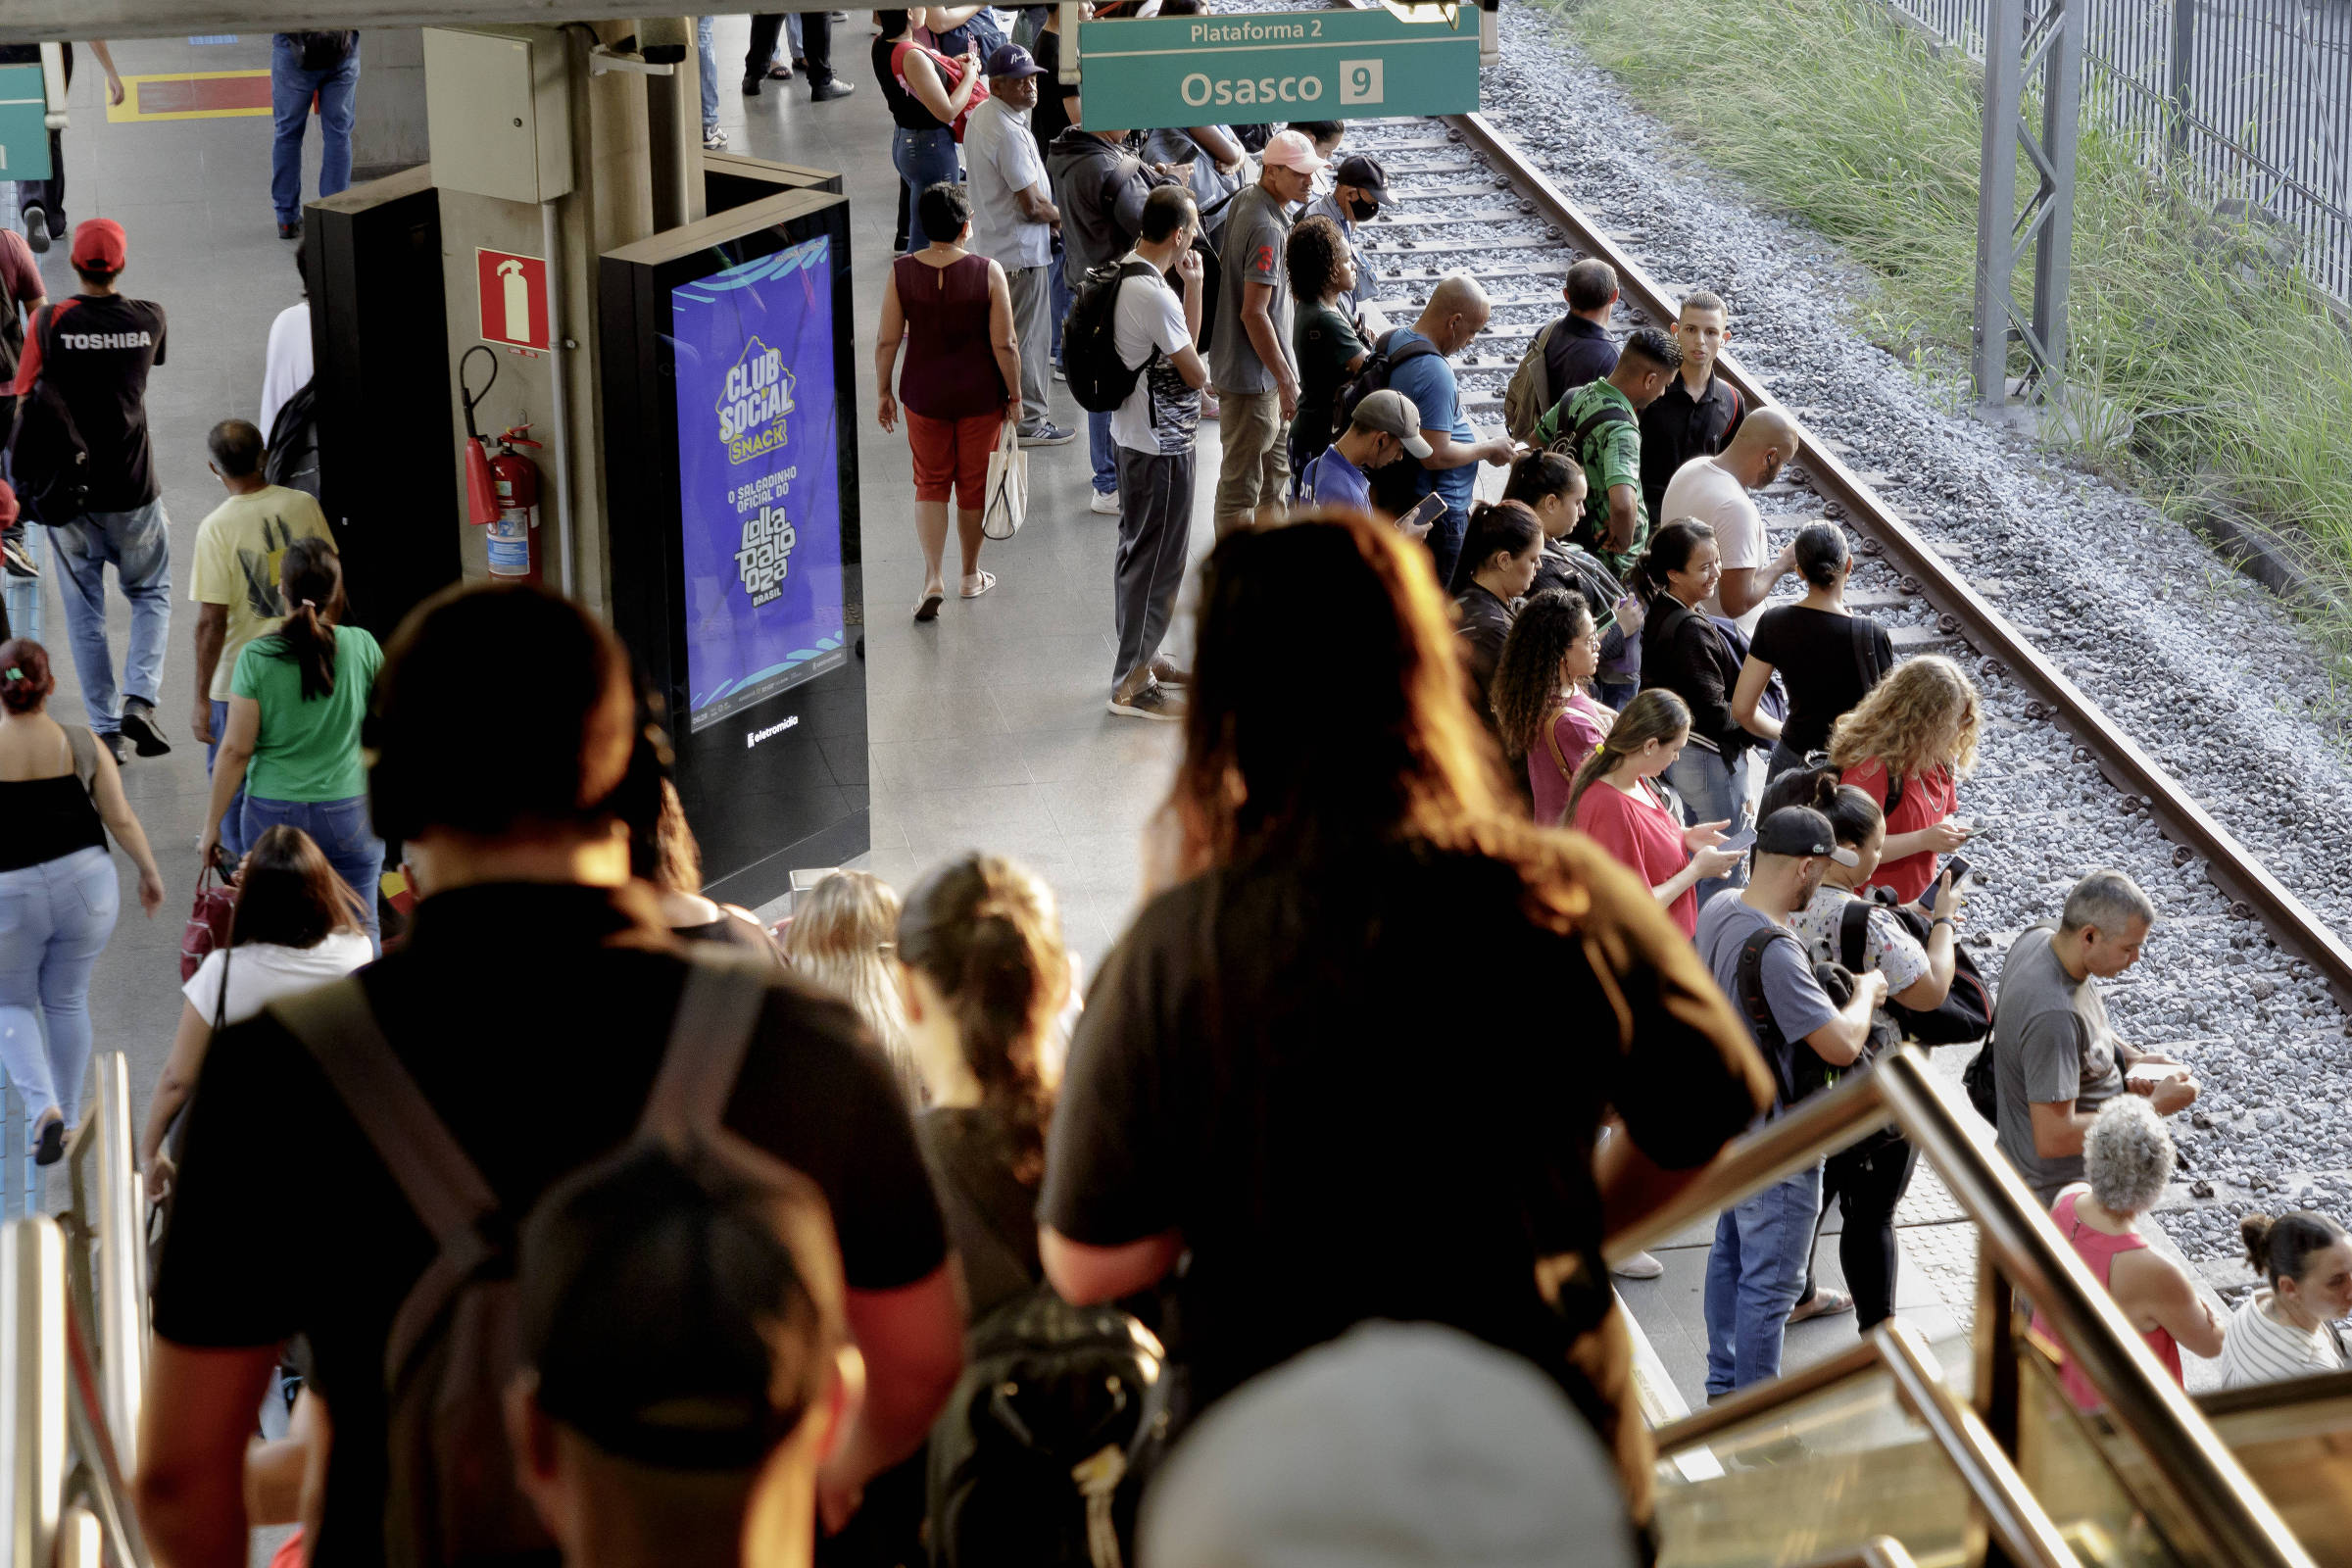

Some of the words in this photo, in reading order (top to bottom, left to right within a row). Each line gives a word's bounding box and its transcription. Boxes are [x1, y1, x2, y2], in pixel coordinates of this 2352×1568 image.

[1191, 22, 1304, 42] Plataforma
[1310, 20, 1323, 37] 2
[1181, 73, 1323, 107] Osasco
[1351, 67, 1372, 97] 9
[61, 330, 152, 350] TOSHIBA
[727, 350, 780, 403] CLUB
[732, 424, 784, 460] SNACK
[728, 490, 735, 504] O
[737, 466, 797, 500] SALGADINHO
[737, 489, 773, 514] OFICIAL
[776, 481, 789, 498] DO
[753, 588, 782, 607] BRASIL
